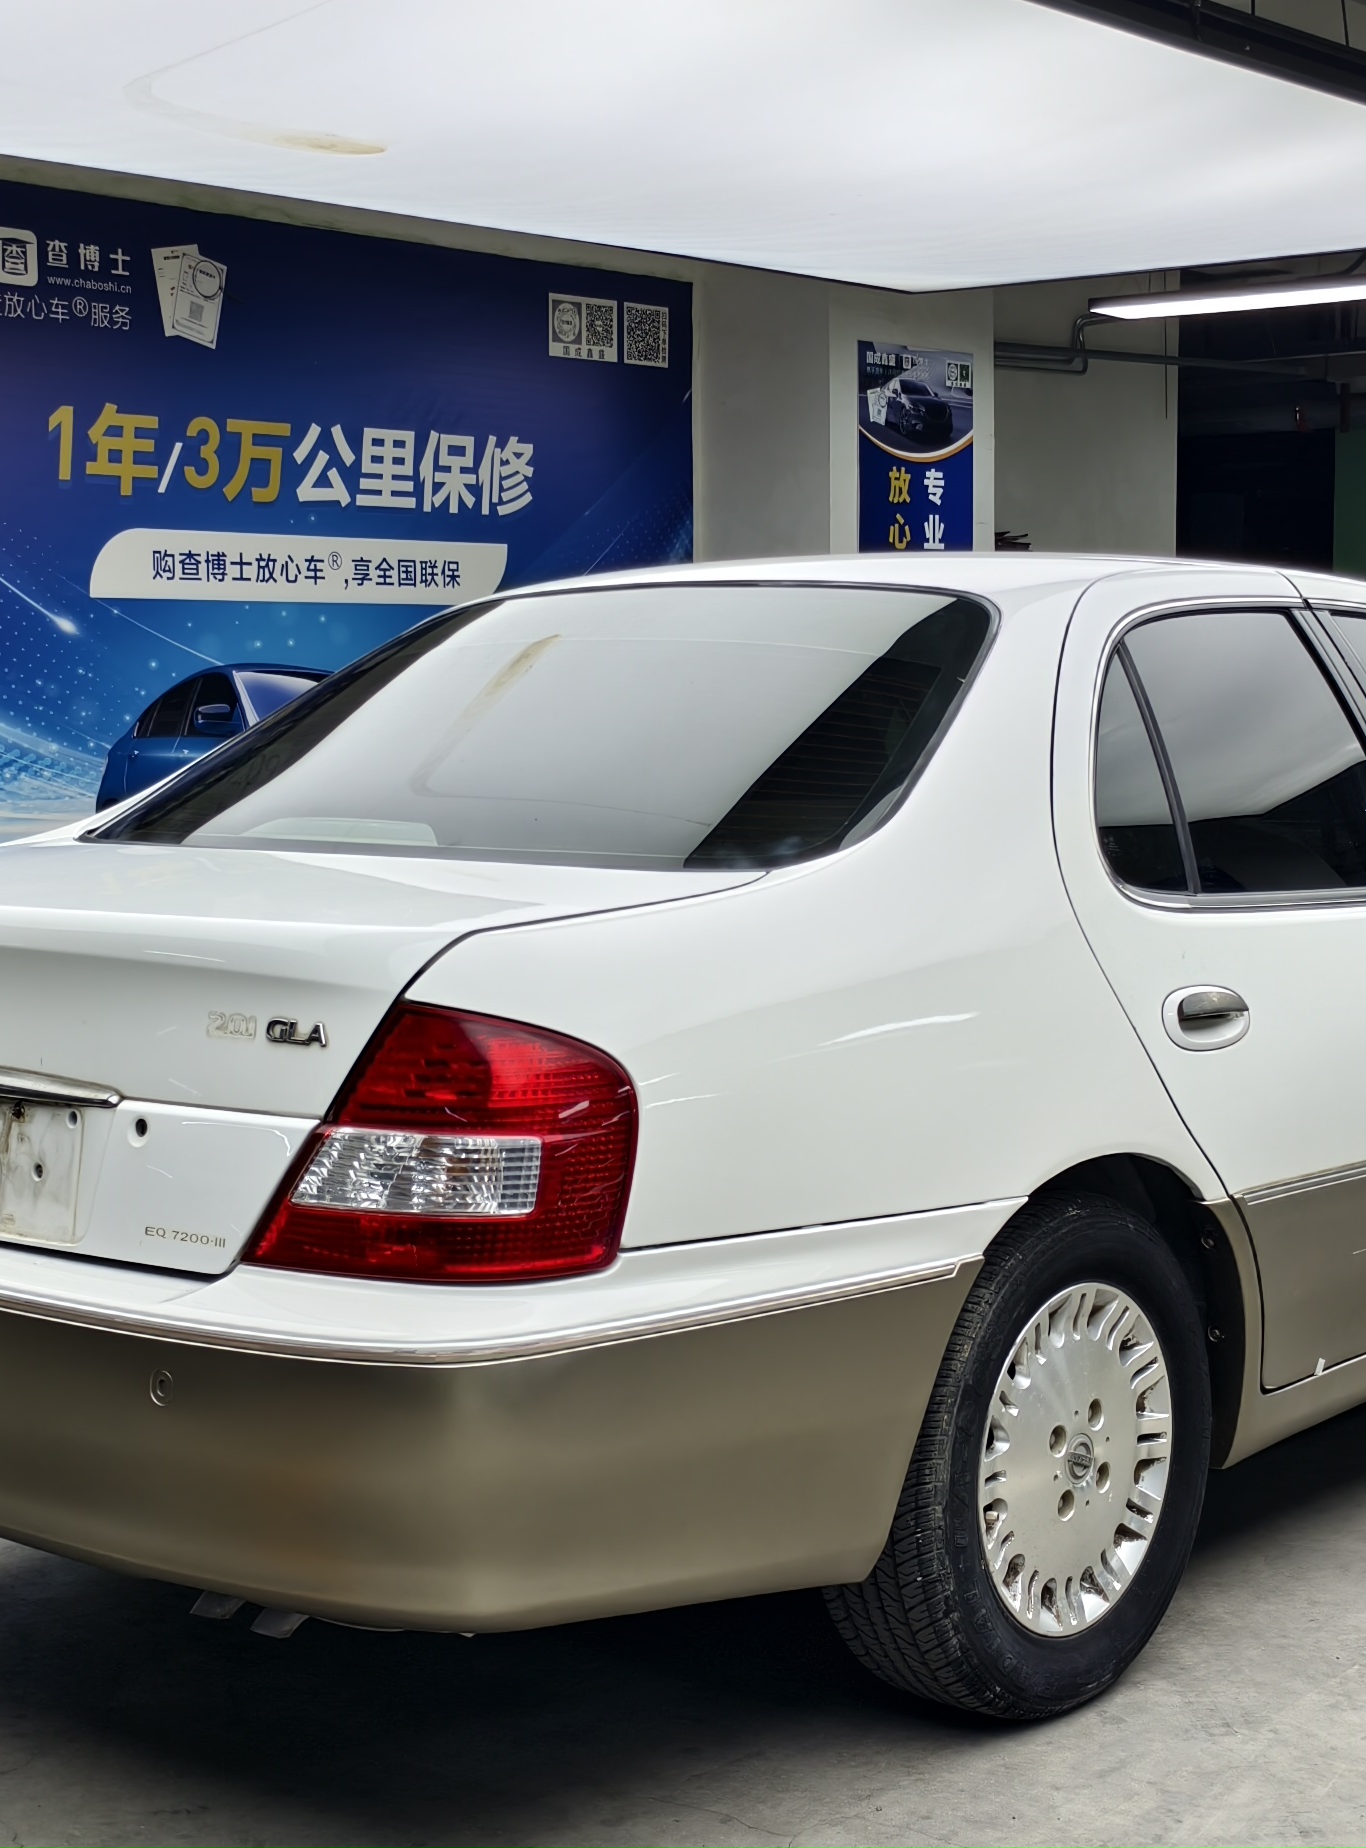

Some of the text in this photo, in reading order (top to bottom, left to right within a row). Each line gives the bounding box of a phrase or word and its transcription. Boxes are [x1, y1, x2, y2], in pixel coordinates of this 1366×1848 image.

[46, 239, 131, 276] 查博士
[47, 274, 132, 294] www.chaboshi.cn
[48, 402, 534, 517] 1年/3万公里保修
[888, 466, 911, 550] 放心
[923, 468, 945, 550] 专业
[266, 1017, 327, 1048] GLA
[144, 1226, 167, 1239] EQ
